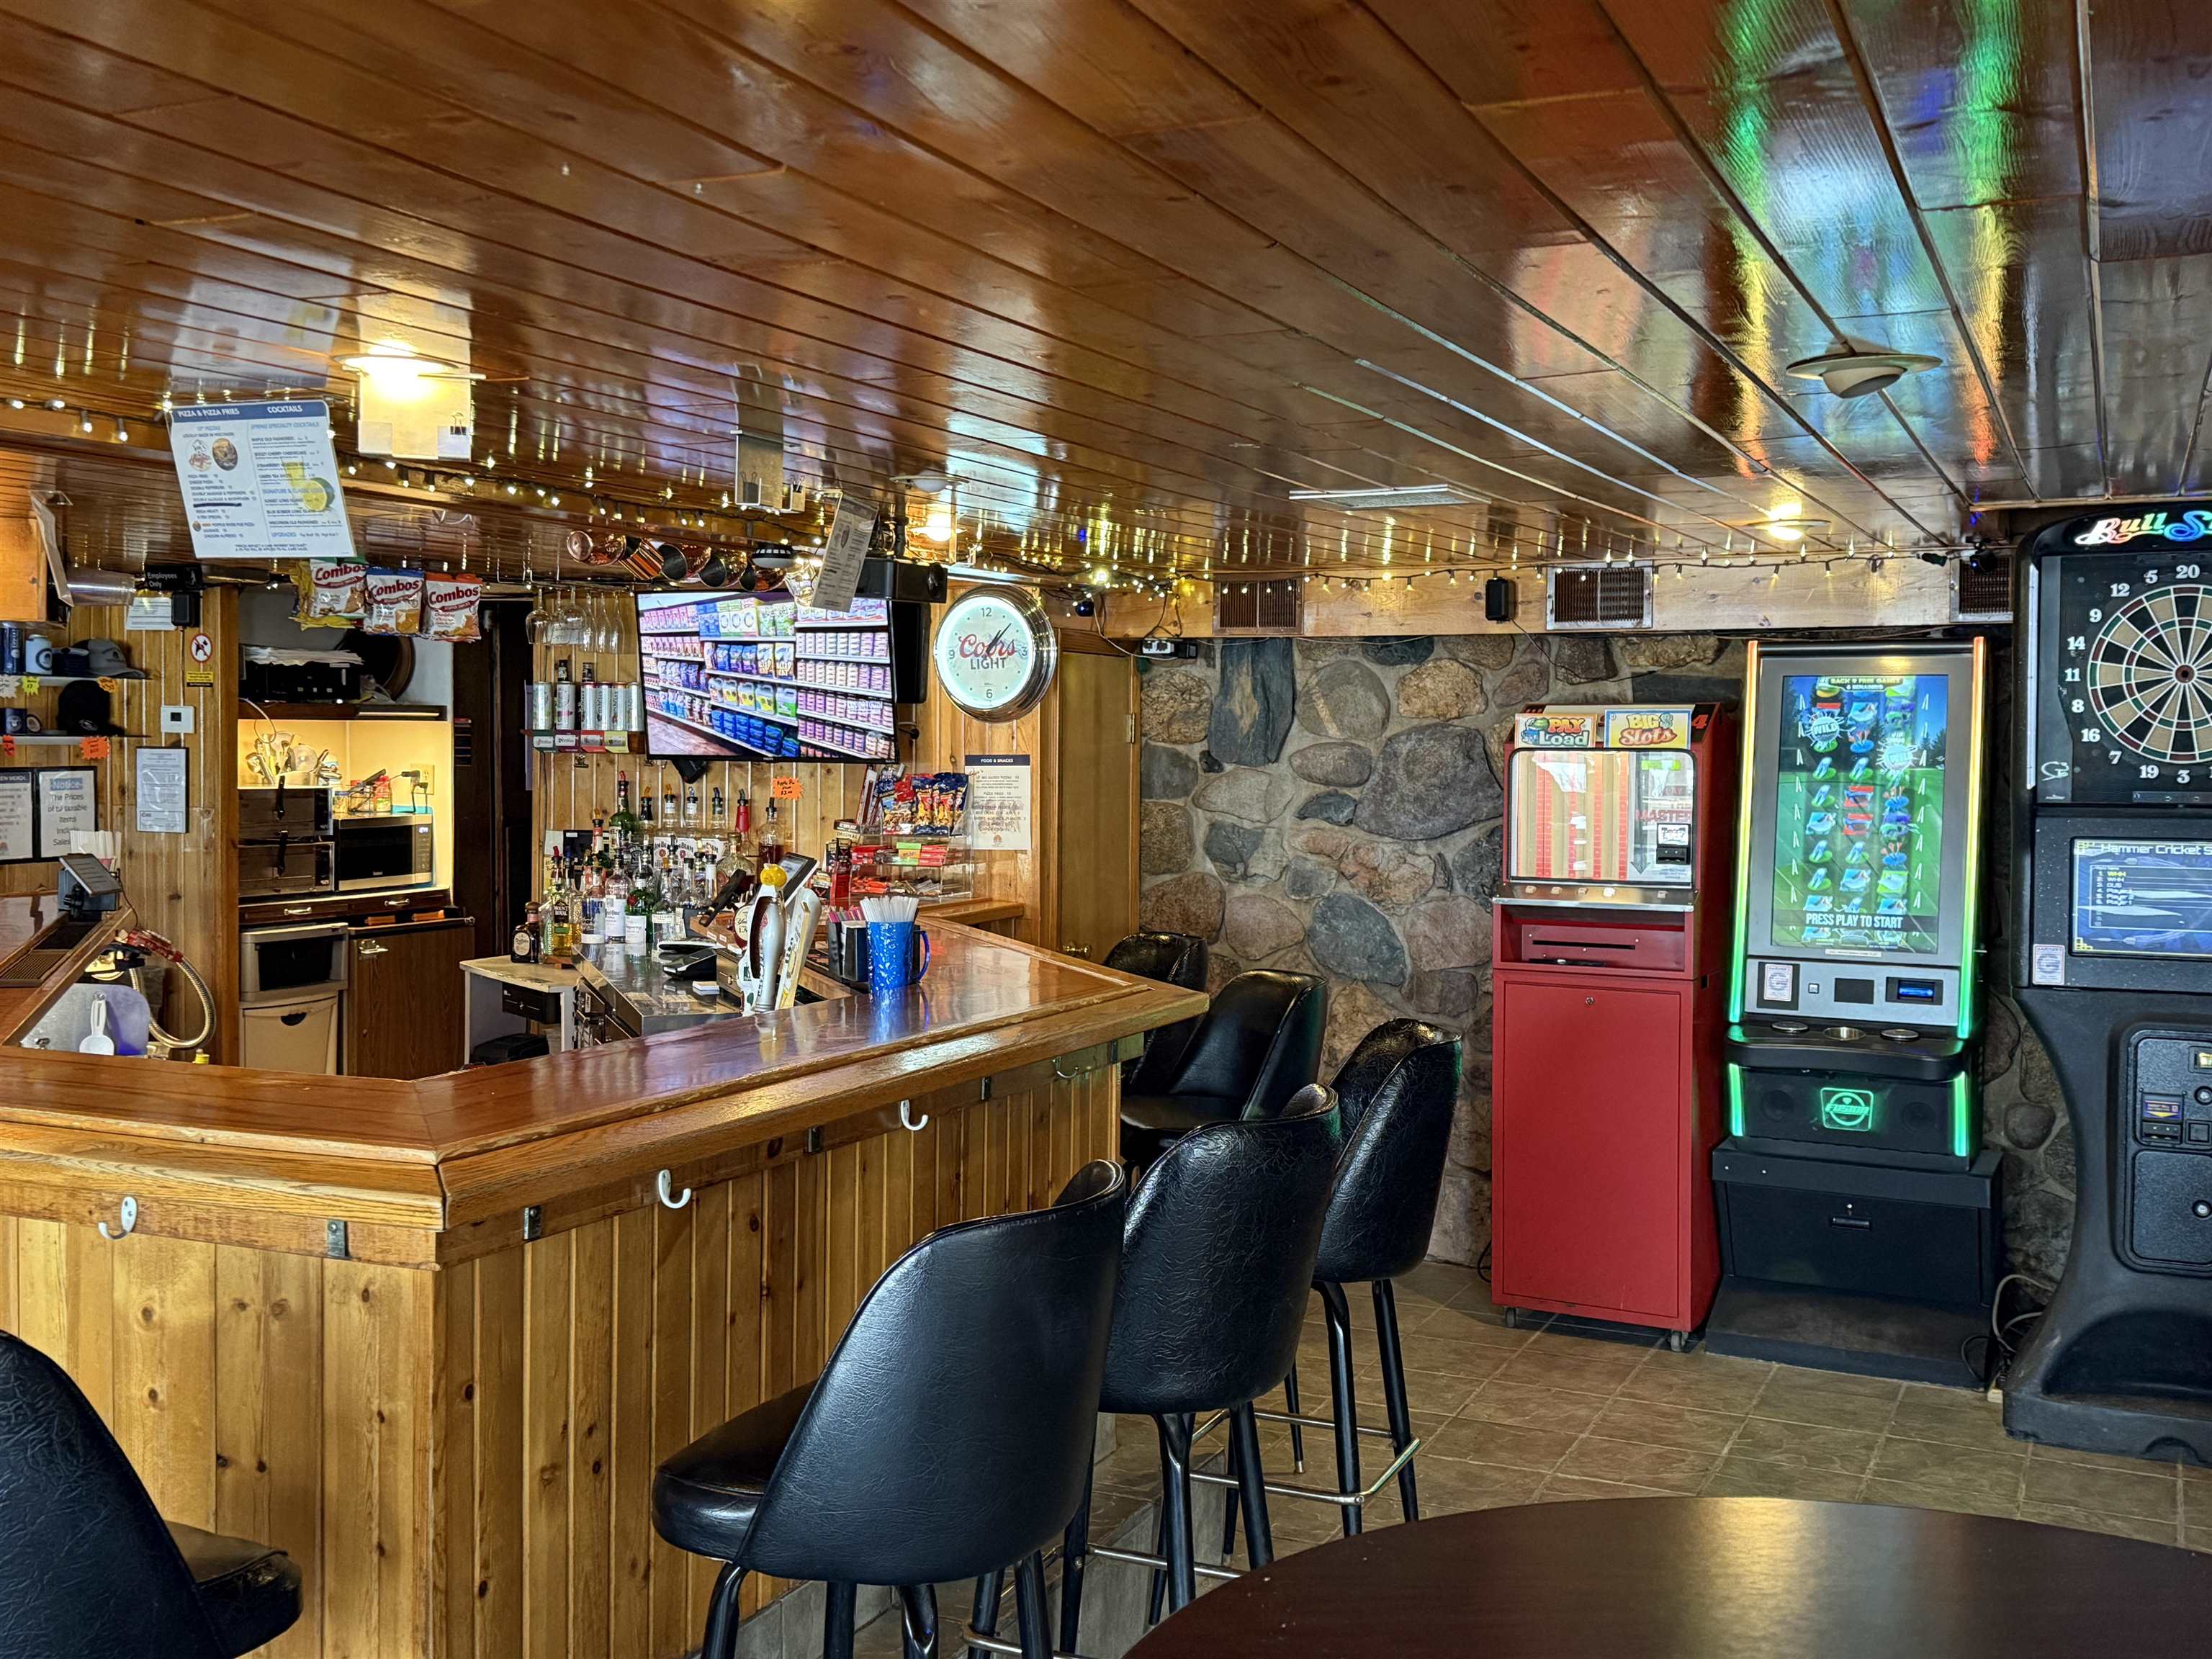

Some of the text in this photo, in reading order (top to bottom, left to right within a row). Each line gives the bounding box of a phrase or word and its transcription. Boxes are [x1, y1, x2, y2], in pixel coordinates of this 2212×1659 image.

[315, 564, 369, 580] Combos
[2144, 570, 2159, 584] 5
[2176, 565, 2200, 579] 20
[372, 579, 419, 597] Combos
[428, 586, 479, 604] Combos
[2110, 583, 2131, 597] 12
[981, 607, 992, 617] 12
[2089, 608, 2103, 622] 9
[958, 634, 1017, 658] Coors
[2067, 636, 2086, 650] 14
[948, 649, 956, 659] 9
[1021, 647, 1028, 656] 3
[970, 657, 1007, 670] LIGHT
[2064, 668, 2081, 682] 11
[986, 688, 993, 698] 6
[2071, 699, 2085, 713] 8
[1548, 717, 1586, 734] PAY
[1693, 714, 1709, 729] 4
[1813, 722, 1837, 735] WILD
[1538, 731, 1589, 747] Load
[1619, 728, 1678, 746] Slots
[2081, 728, 2101, 742] 16
[2108, 750, 2123, 764] 7
[2139, 765, 2159, 779] 19
[2177, 770, 2190, 783] 3
[2100, 844, 2212, 855] Hammer Cricket S
[1806, 912, 1903, 929] PRESS PLAY TO START
